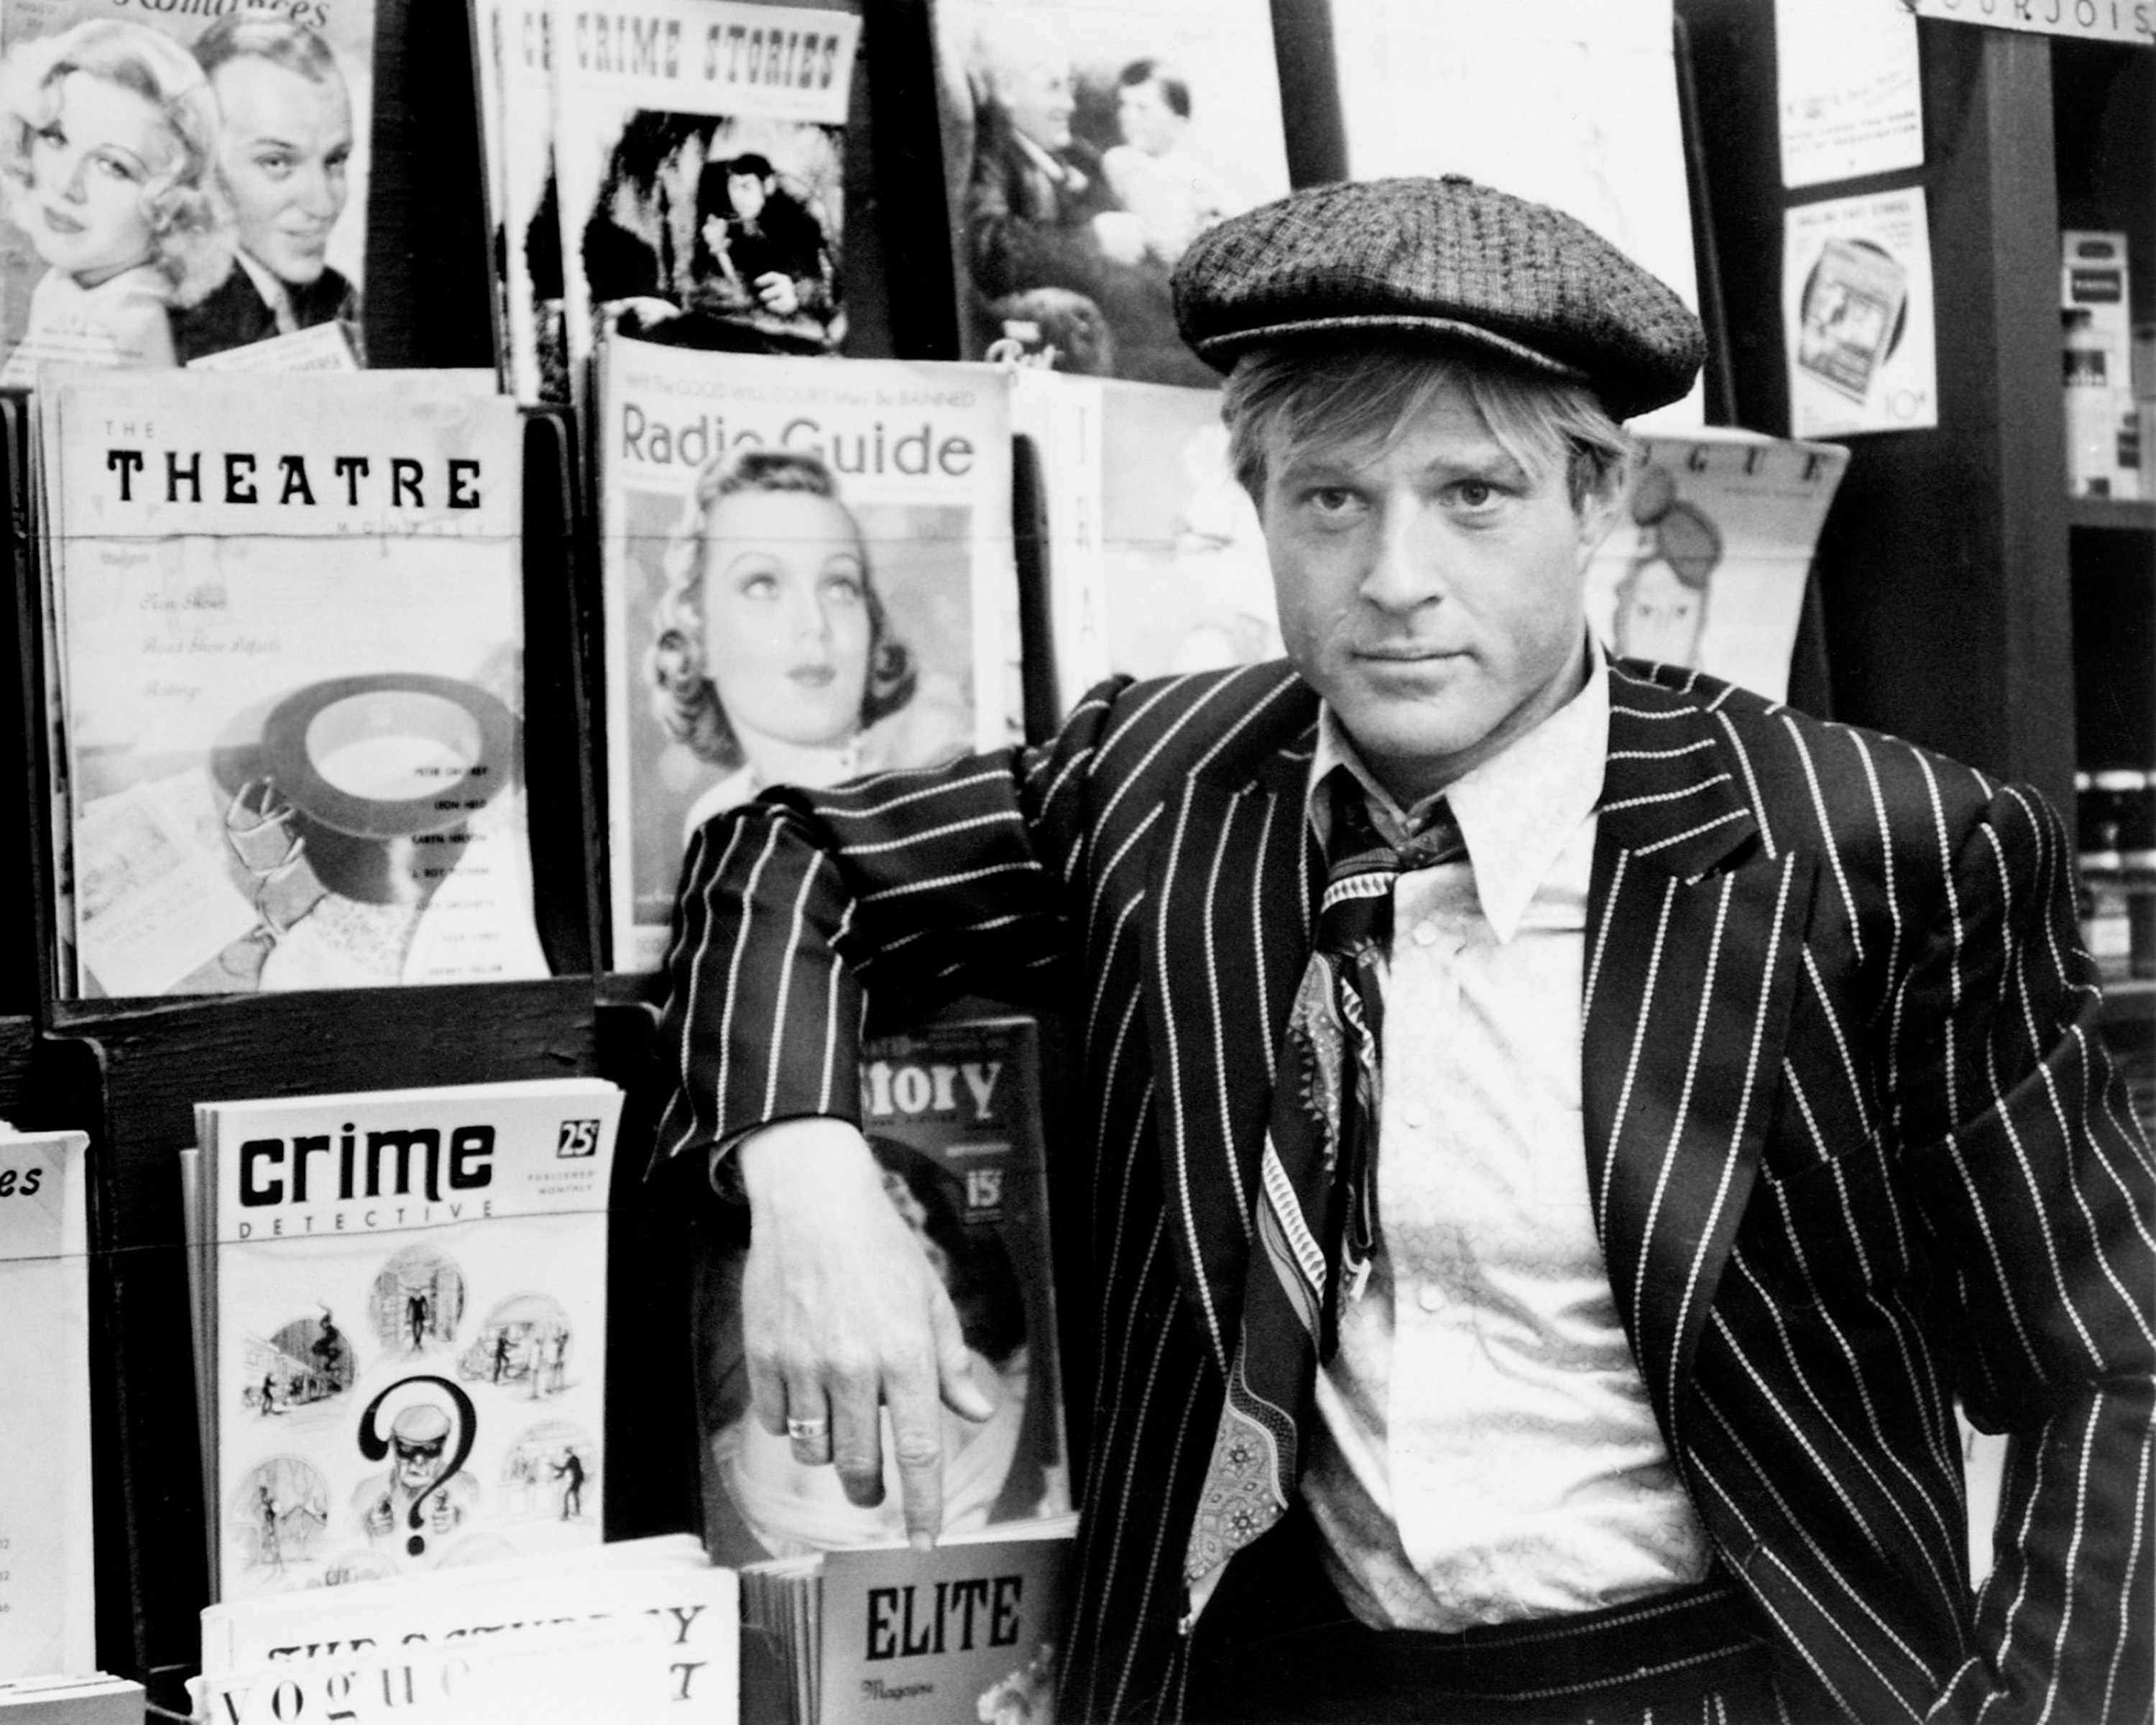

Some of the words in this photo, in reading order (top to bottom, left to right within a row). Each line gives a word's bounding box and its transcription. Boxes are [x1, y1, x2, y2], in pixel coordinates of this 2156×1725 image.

[577, 11, 680, 79] CRIME
[704, 22, 840, 90] STORIES
[105, 420, 155, 439] THE
[107, 449, 482, 510] THEATRE
[861, 1059, 1002, 1120] tory
[239, 1122, 496, 1208] crime
[239, 1200, 492, 1240] DETECTIVE
[865, 1576, 1023, 1661] ELITE
